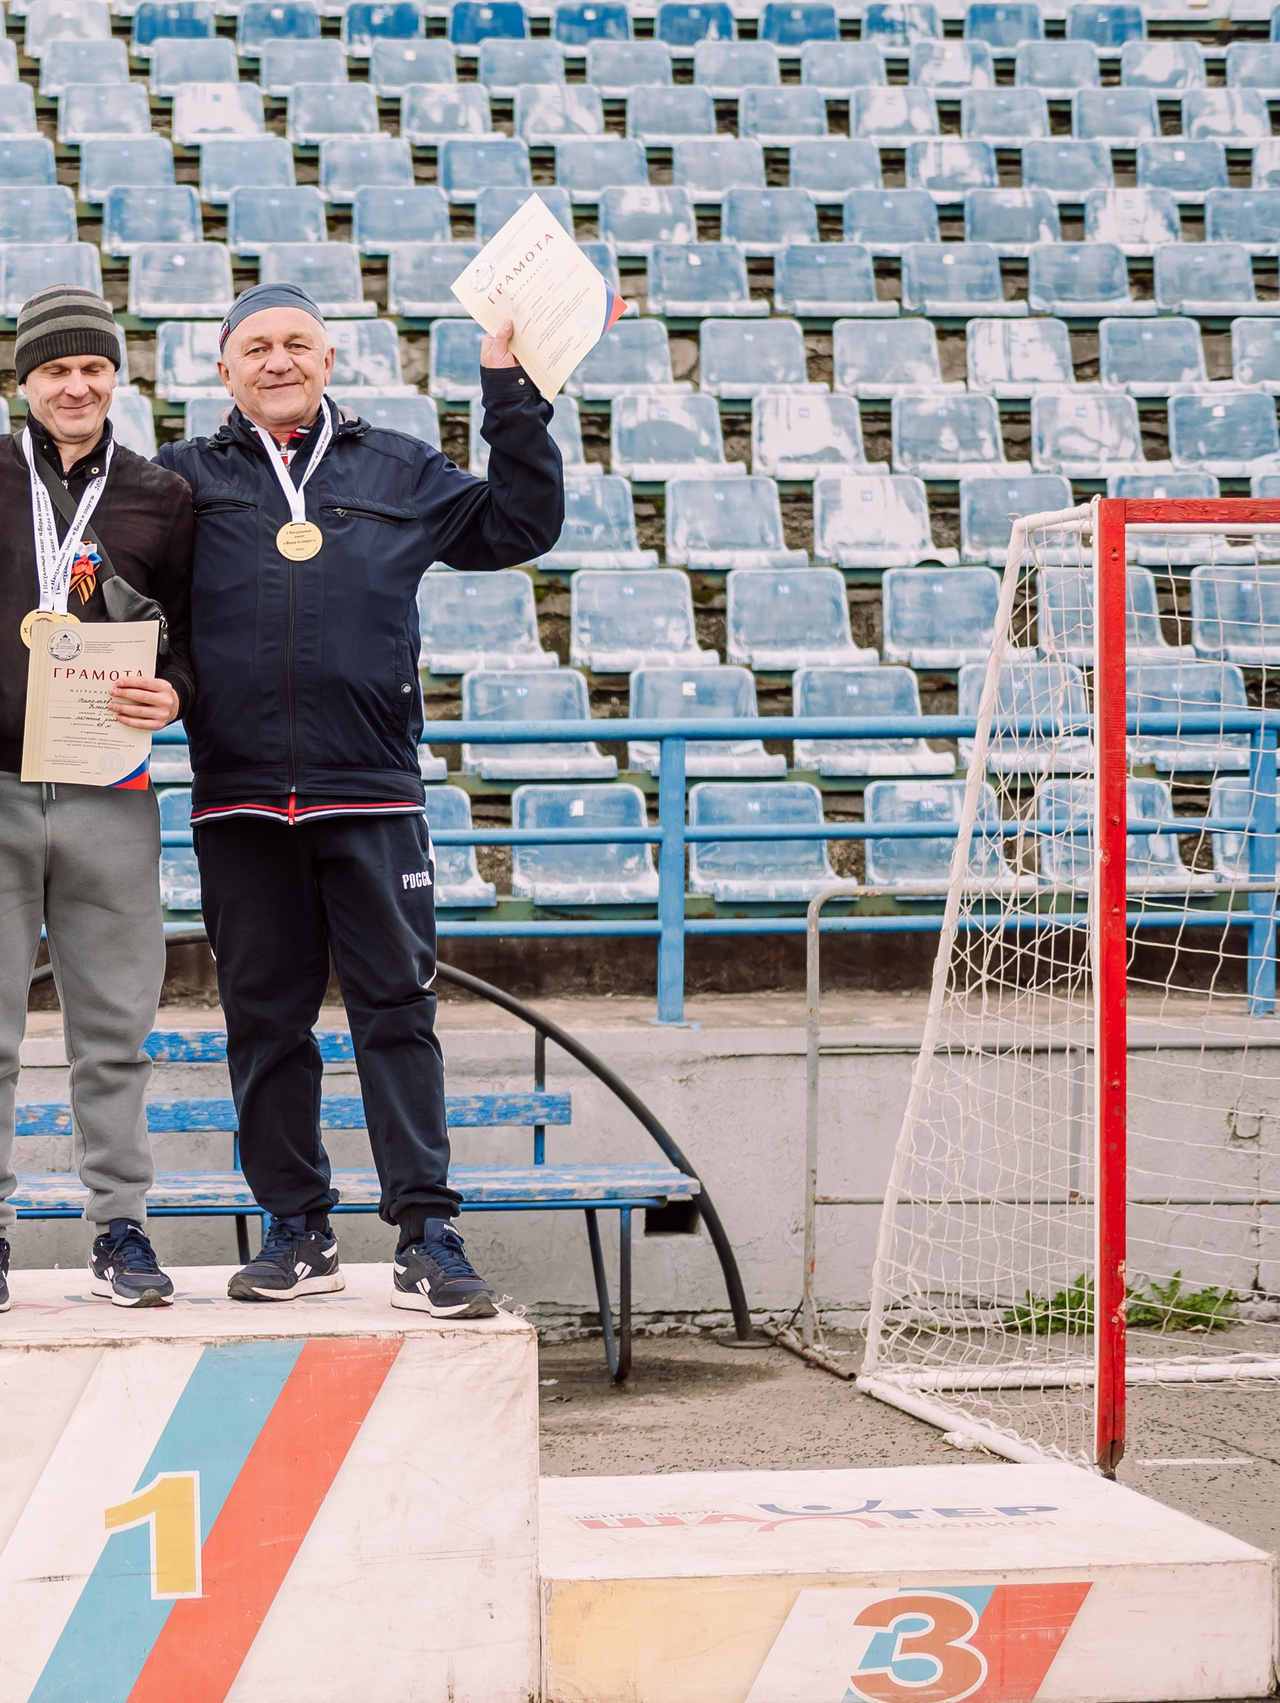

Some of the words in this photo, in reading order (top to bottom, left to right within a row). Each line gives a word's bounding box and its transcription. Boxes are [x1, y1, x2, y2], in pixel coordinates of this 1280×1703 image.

[488, 233, 554, 304] ГРАМОТА
[54, 668, 142, 680] ГРАМОТА
[103, 1470, 202, 1600] 1
[578, 1500, 1060, 1532] ШАХТЕР
[896, 1520, 1058, 1530] СТАДИОН
[849, 1589, 989, 1703] 3
